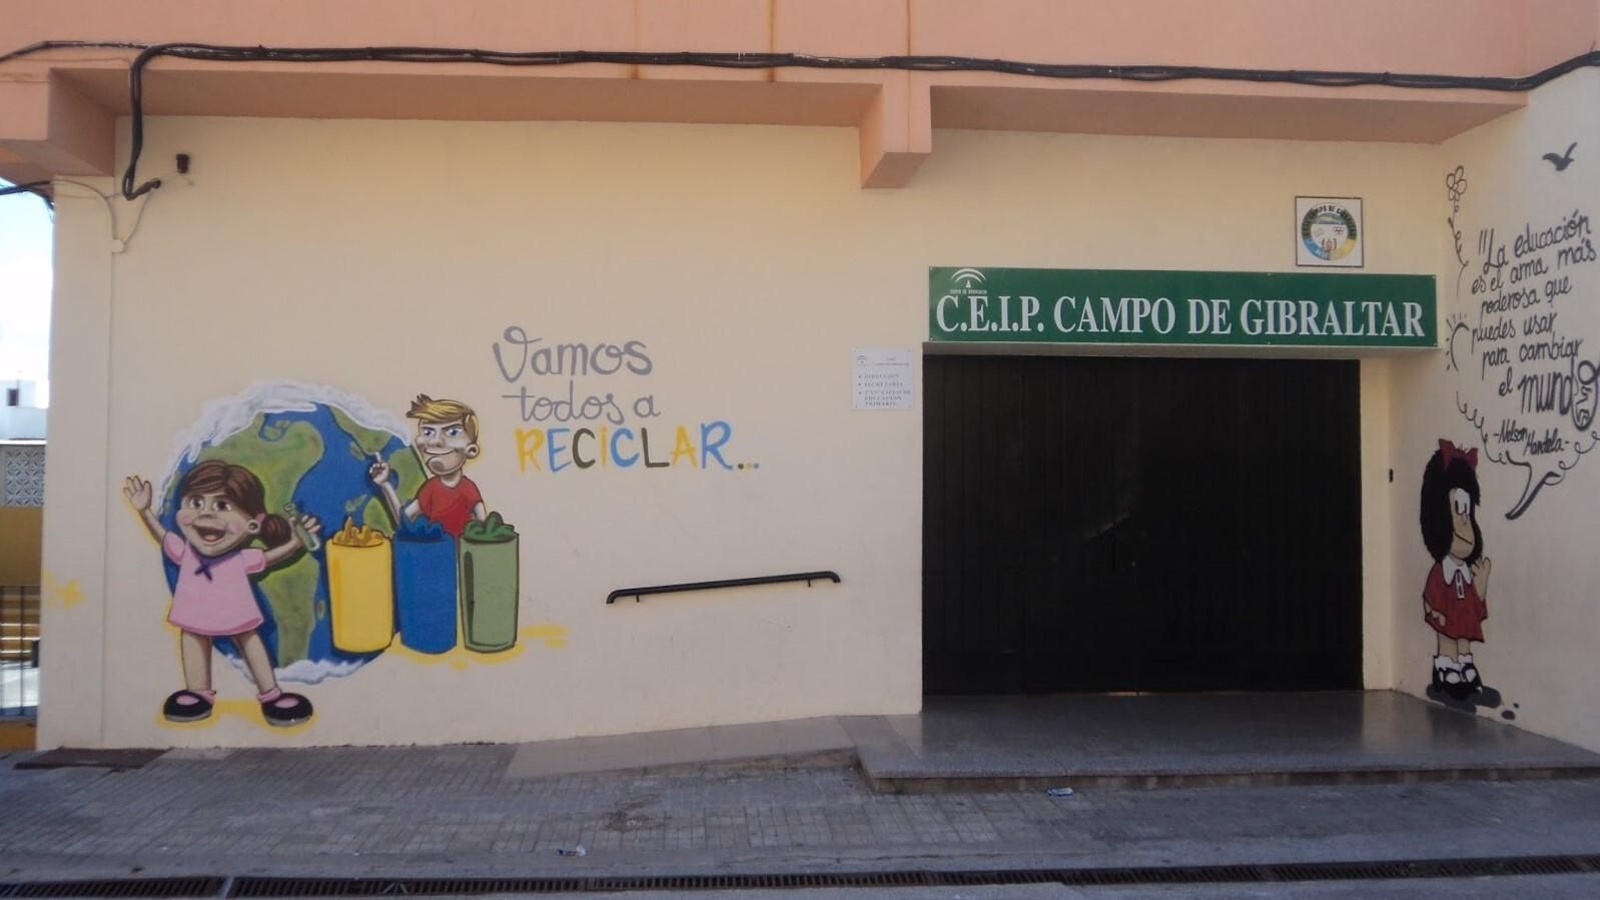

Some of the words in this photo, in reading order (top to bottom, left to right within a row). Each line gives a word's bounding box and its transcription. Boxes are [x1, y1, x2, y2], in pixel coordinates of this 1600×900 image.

[1514, 209, 1591, 258] educación
[1471, 275, 1487, 294] es
[1490, 269, 1504, 292] el
[1510, 258, 1549, 284] arma
[1557, 237, 1597, 270] más
[936, 295, 1045, 332] C.E.I.P.
[1053, 296, 1176, 334] CAMPO
[1187, 299, 1232, 335] DE
[1239, 299, 1426, 337] GIBRALTAR
[1480, 288, 1541, 327] poderosa
[1545, 276, 1573, 308] que
[491, 325, 653, 383] Vamos
[1471, 316, 1516, 355] puedes
[1523, 312, 1558, 336] usar
[1481, 347, 1510, 381] para
[1519, 331, 1584, 362] cambiar
[501, 379, 625, 425] todos
[633, 394, 661, 418] a
[1499, 366, 1513, 397] el
